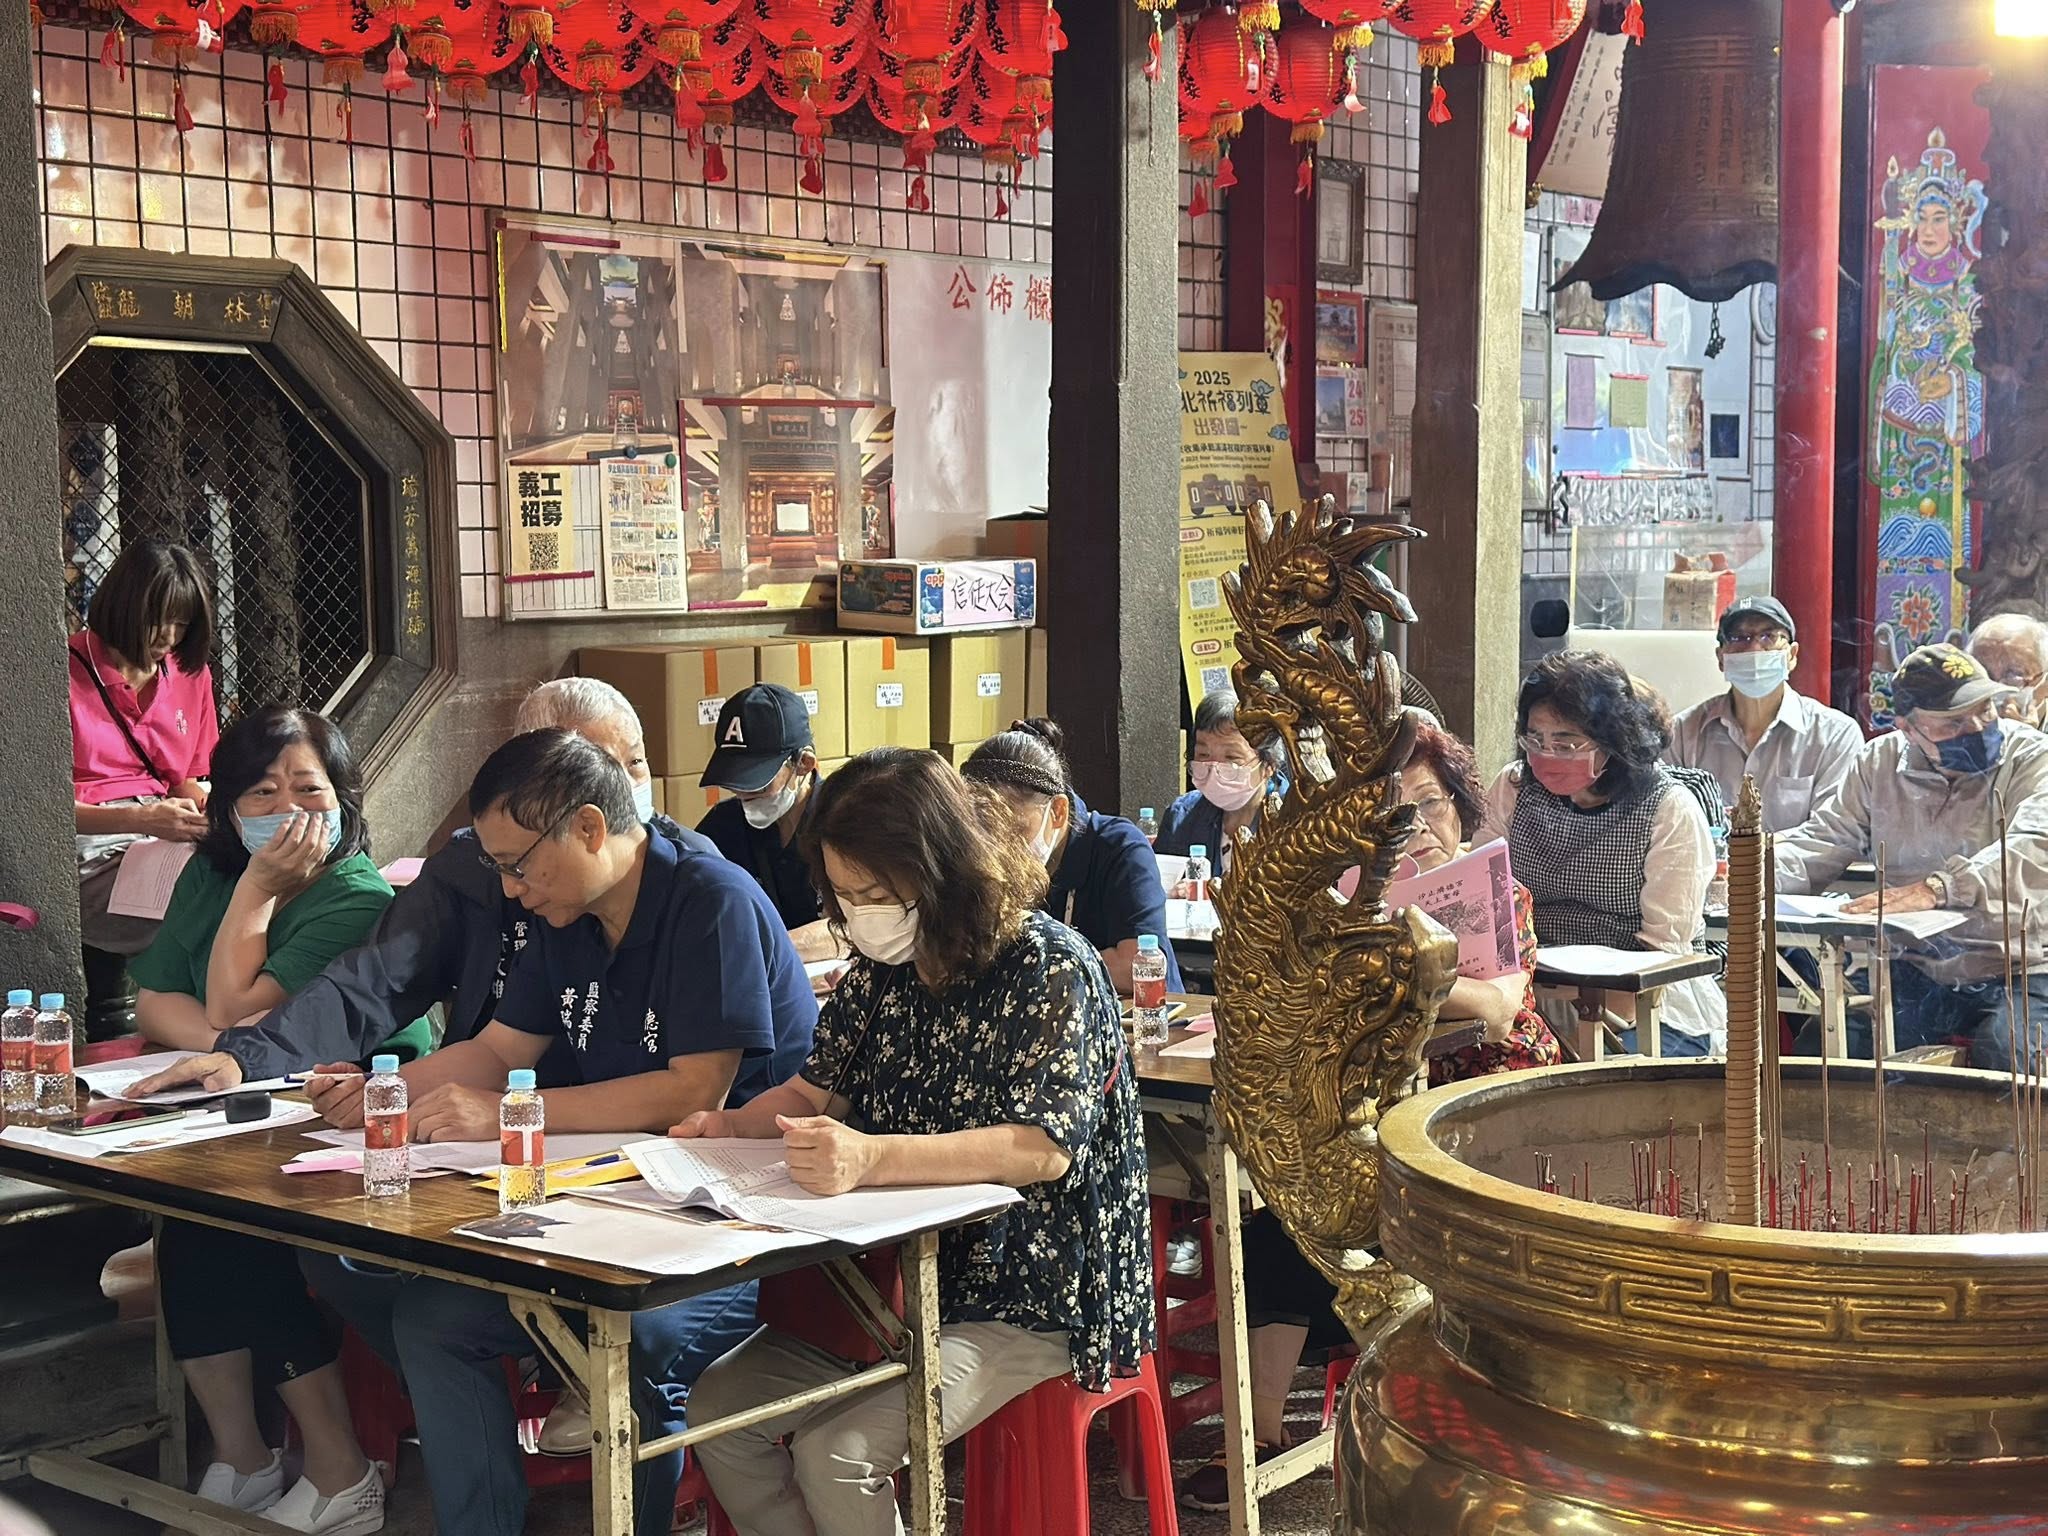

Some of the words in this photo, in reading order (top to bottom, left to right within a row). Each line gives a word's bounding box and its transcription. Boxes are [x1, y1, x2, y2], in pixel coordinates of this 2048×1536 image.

[1194, 370, 1231, 386] 2025
[1348, 380, 1362, 399] 24
[1350, 408, 1364, 426] 25
[518, 471, 562, 498] 義工
[520, 500, 563, 527] 招募
[724, 716, 744, 743] A
[560, 987, 579, 1046] 黃瑞
[577, 981, 600, 1051] 監察委員
